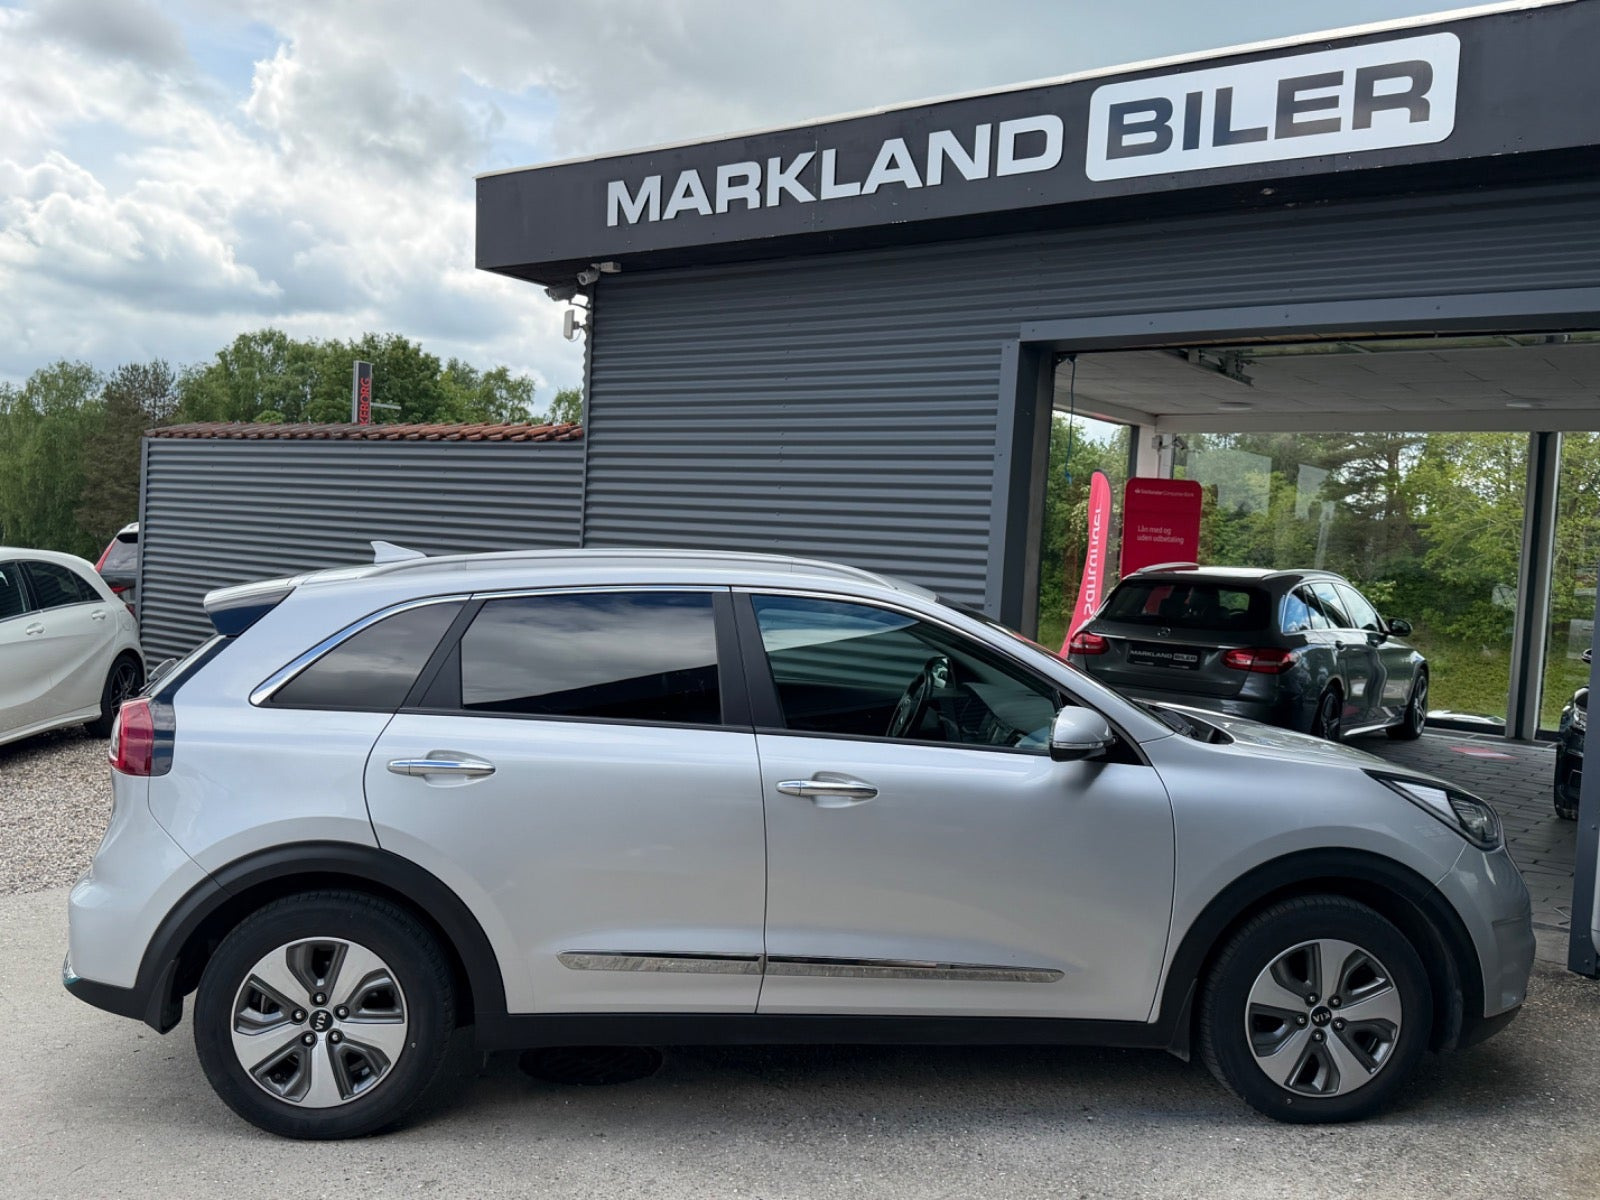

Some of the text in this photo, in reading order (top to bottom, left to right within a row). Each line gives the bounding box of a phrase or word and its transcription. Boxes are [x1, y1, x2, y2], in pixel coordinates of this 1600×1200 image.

[606, 59, 1432, 227] MARKLAND BILER
[1137, 525, 1148, 533] Lån
[1149, 526, 1163, 534] med
[1137, 534, 1185, 545] uden udbetaling
[1129, 649, 1197, 662] MARKLAND BILER
[315, 1012, 327, 1030] KIA
[1312, 1011, 1331, 1023] KIA
